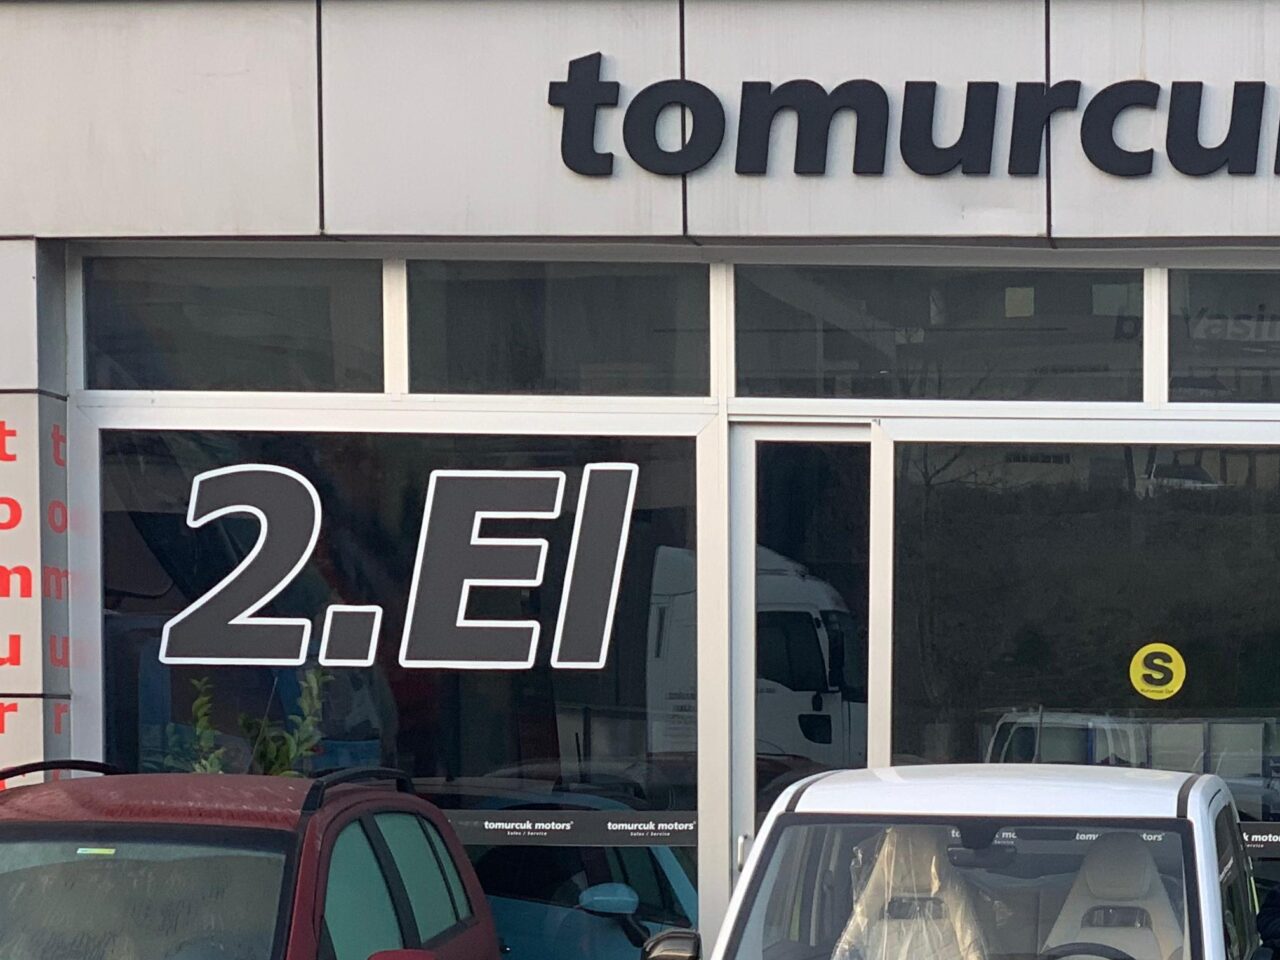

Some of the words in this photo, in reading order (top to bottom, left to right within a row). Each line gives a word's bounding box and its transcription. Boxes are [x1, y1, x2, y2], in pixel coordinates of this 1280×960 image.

[158, 463, 639, 670] 2.El
[1142, 651, 1174, 686] S
[484, 820, 533, 830] tomurcuk
[607, 820, 656, 830] tomurcuk
